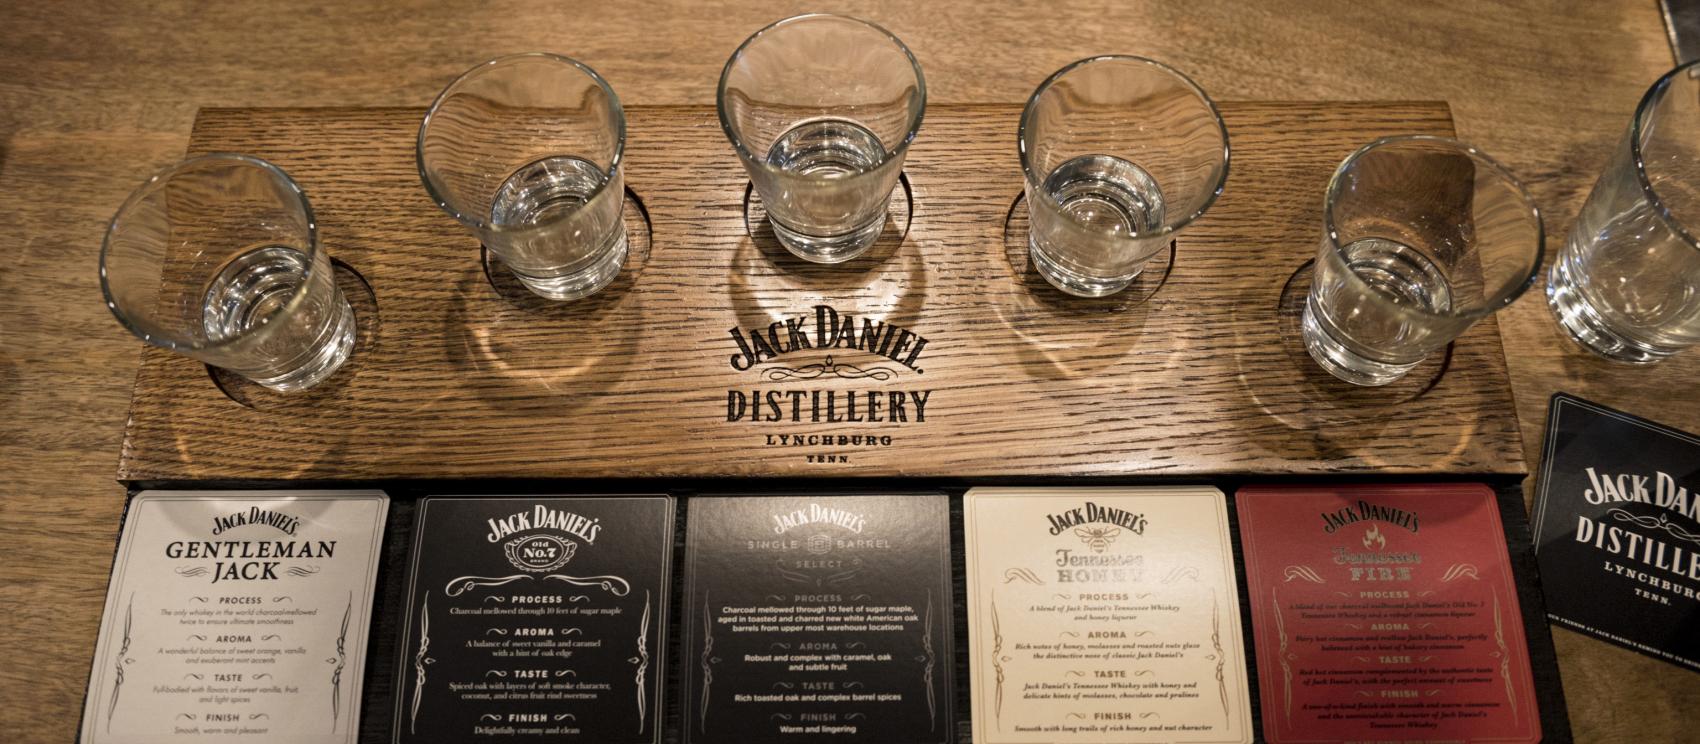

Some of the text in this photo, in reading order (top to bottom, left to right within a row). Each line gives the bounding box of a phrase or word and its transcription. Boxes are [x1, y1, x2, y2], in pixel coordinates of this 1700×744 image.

[728, 304, 929, 374] JACK DANIEL.
[727, 390, 932, 423] DISTILLERY
[766, 434, 892, 446] LYNCHBURG
[1584, 467, 1651, 505] JACK
[212, 506, 300, 536] JACK DANIEL'S
[774, 503, 866, 534] JACK DANIEL'S
[1047, 502, 1148, 536] JACK DANIEL'S
[1320, 499, 1419, 534] JACK DANIEL'S
[487, 504, 602, 544] JACK DANIEL'S
[748, 540, 891, 549] SINGLE BARREL
[166, 541, 336, 558] GENTLEMAN
[523, 548, 557, 558] No.7
[796, 560, 842, 568] SELECT
[211, 562, 280, 584] JACK
[1349, 567, 1414, 581] FIRE
[795, 594, 842, 602] PROCESS
[1360, 591, 1409, 599] PROCESS
[1635, 588, 1673, 606] TENN.
[796, 606, 827, 614] through
[718, 614, 738, 623] aged
[739, 614, 746, 622] in
[748, 614, 777, 622] toasted
[779, 614, 793, 622] and
[795, 614, 824, 622] charred
[843, 614, 865, 622] white
[866, 614, 903, 622] American
[904, 614, 919, 622] oak
[732, 623, 904, 633] barrels from upper most warehouse locations
[1561, 618, 1585, 629] FRIENDS
[1595, 629, 1610, 638] JACK
[216, 635, 252, 643] AROMA
[799, 642, 837, 650] AROMA
[790, 654, 823, 662] complex
[789, 663, 848, 671] and subtle fruit
[214, 674, 243, 682] TASTE
[514, 670, 548, 678] TASTE
[803, 682, 835, 690] TASTE
[735, 693, 902, 702] Rich toasted oak and complex barrel spices
[509, 714, 547, 722] FINISH
[800, 713, 836, 721] FINISH
[1094, 712, 1132, 720] FINISH
[822, 725, 857, 734] lingering
